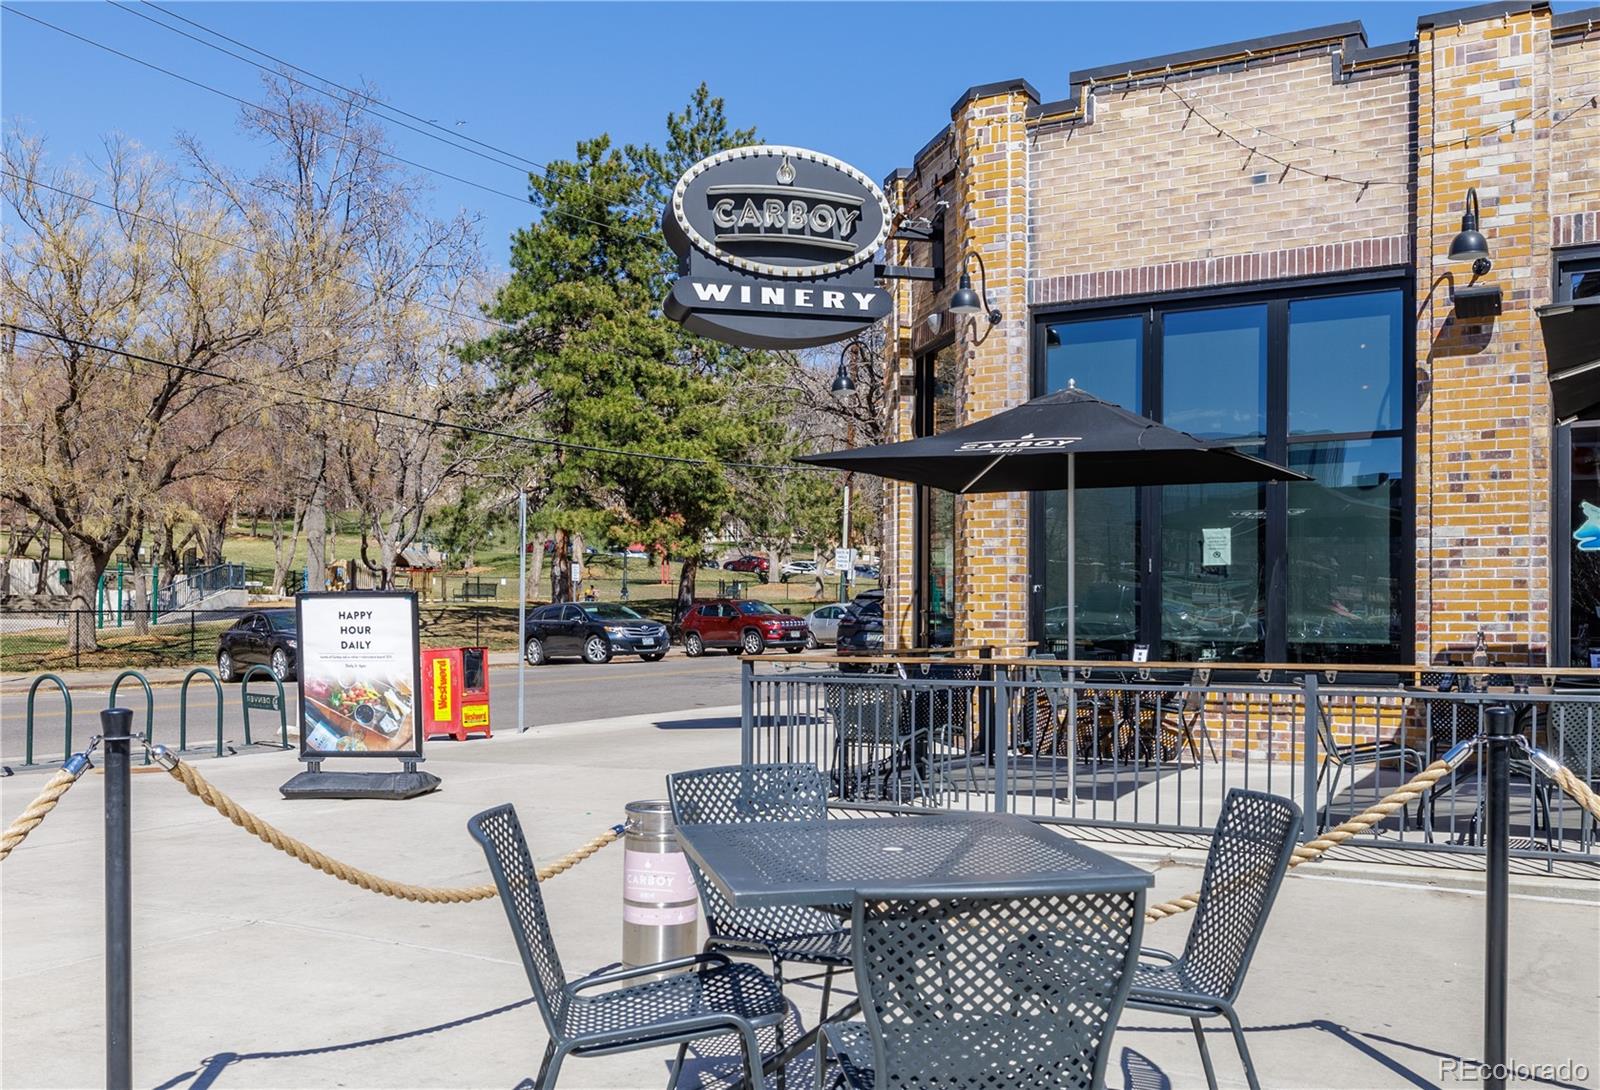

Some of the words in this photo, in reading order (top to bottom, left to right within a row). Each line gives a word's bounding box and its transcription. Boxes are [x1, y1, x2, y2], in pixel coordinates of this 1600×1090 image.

[713, 197, 860, 237] CARBOY
[692, 282, 877, 311] WINERY
[960, 439, 1075, 450] CARBOY
[338, 610, 373, 620] HAPPY
[340, 625, 372, 635] HOUR
[340, 640, 372, 650] DAILY
[437, 659, 448, 711] Westword
[626, 873, 675, 888] CARBOY
